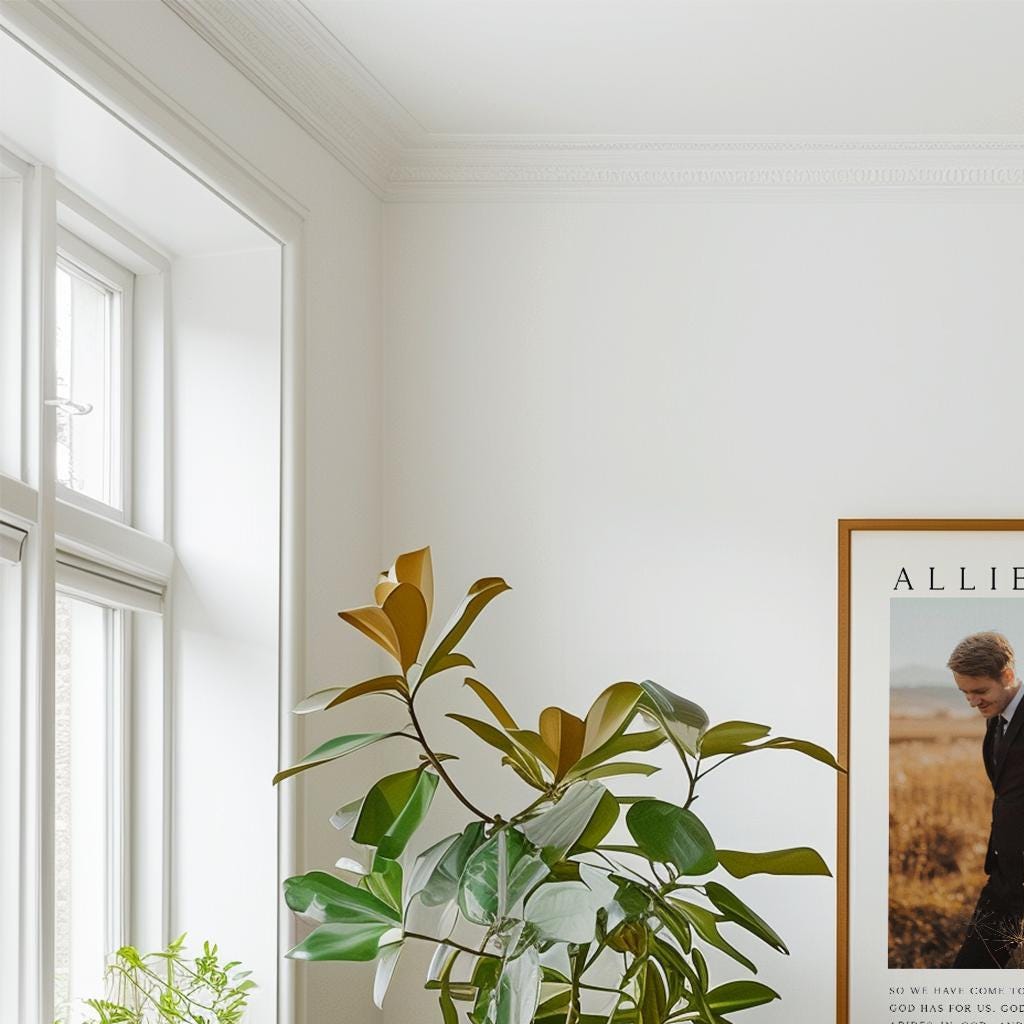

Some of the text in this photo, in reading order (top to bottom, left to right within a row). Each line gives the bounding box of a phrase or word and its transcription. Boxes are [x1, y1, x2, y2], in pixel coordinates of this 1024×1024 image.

[889, 986, 905, 995] SO
[909, 986, 927, 995] WE
[933, 987, 966, 996] HAVE
[969, 987, 1005, 996] COME
[889, 1003, 916, 1013] GOD
[920, 1003, 944, 1013] HAS
[948, 1003, 972, 1014] FOR
